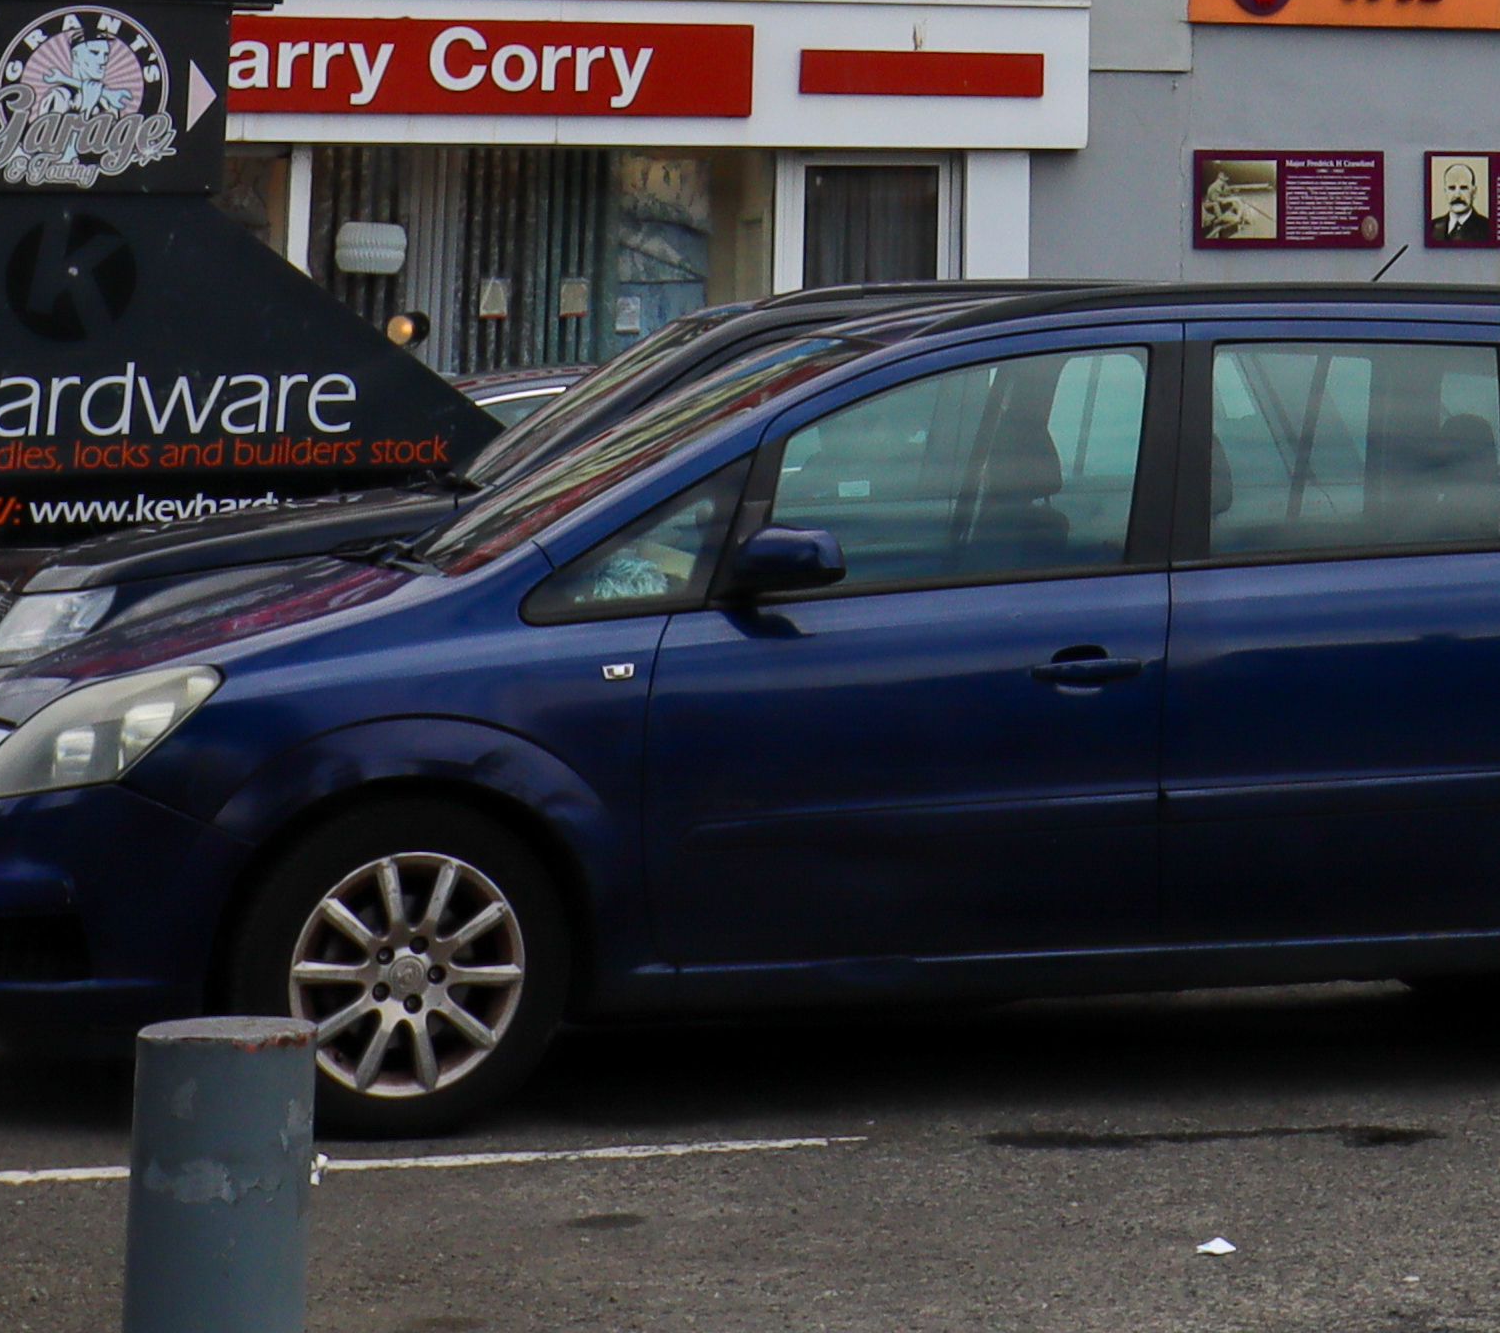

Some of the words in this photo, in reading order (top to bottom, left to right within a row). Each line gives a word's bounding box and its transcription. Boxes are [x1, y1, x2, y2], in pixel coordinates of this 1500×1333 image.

[228, 39, 395, 106] arry
[429, 25, 654, 109] Corry
[28, 153, 100, 189] Towing
[73, 439, 151, 469] locks
[160, 438, 225, 467] and
[370, 435, 450, 464] stock
